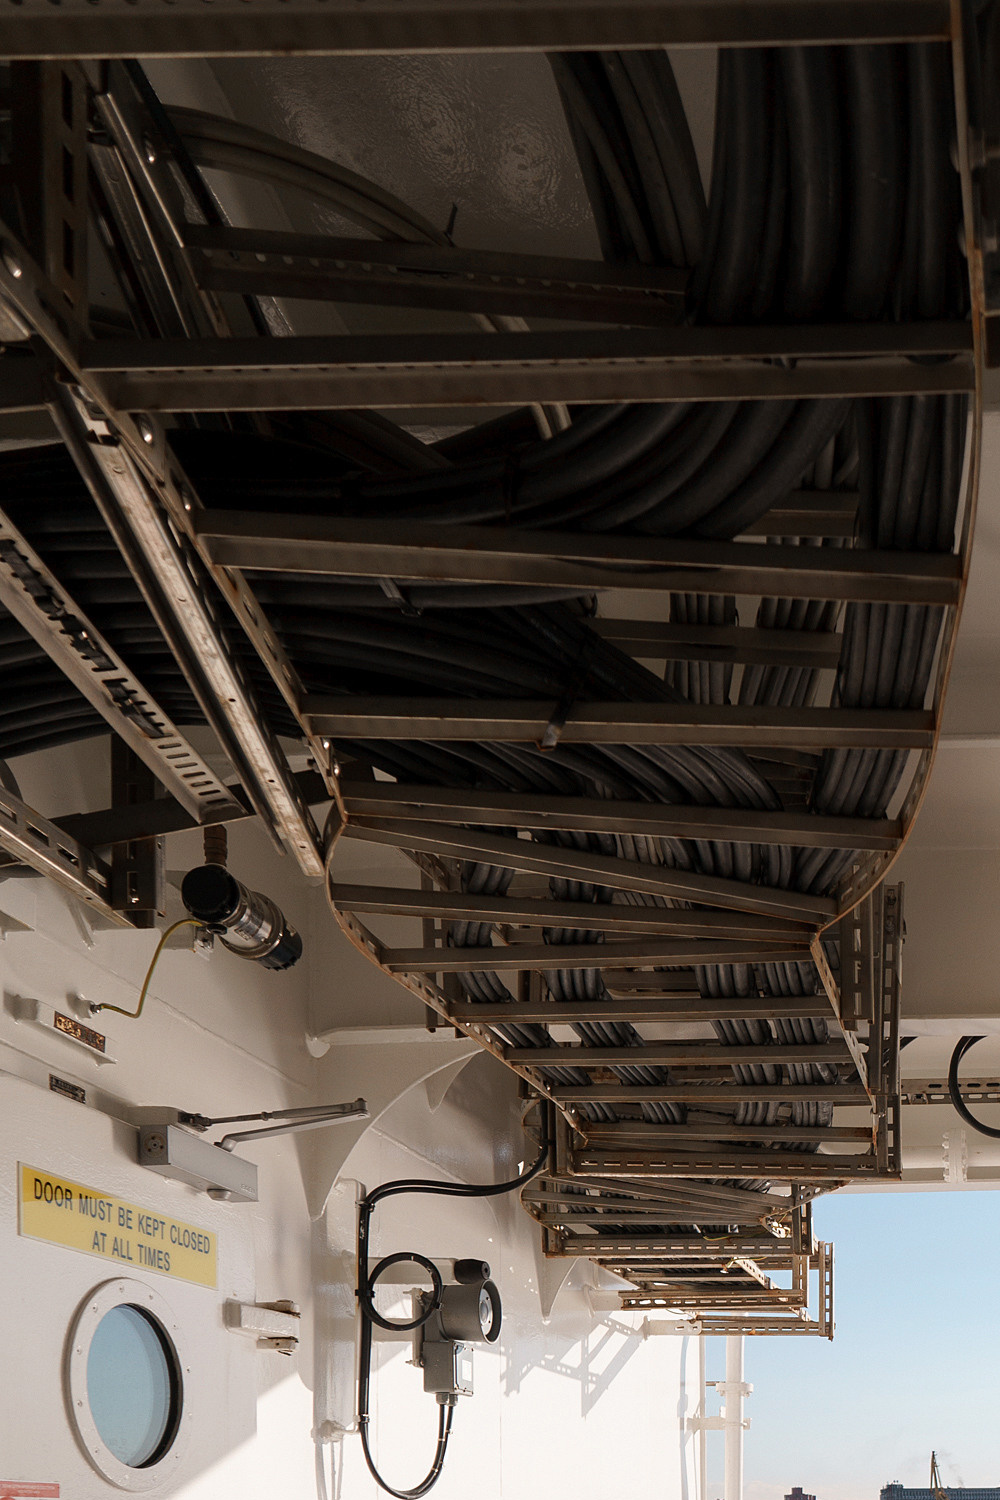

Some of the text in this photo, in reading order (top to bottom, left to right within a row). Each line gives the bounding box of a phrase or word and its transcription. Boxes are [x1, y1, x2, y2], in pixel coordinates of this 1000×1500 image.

[33, 1178, 211, 1255] DOOR MUST BE KEPT CLOSED
[92, 1230, 171, 1272] AT ALL TIMES
